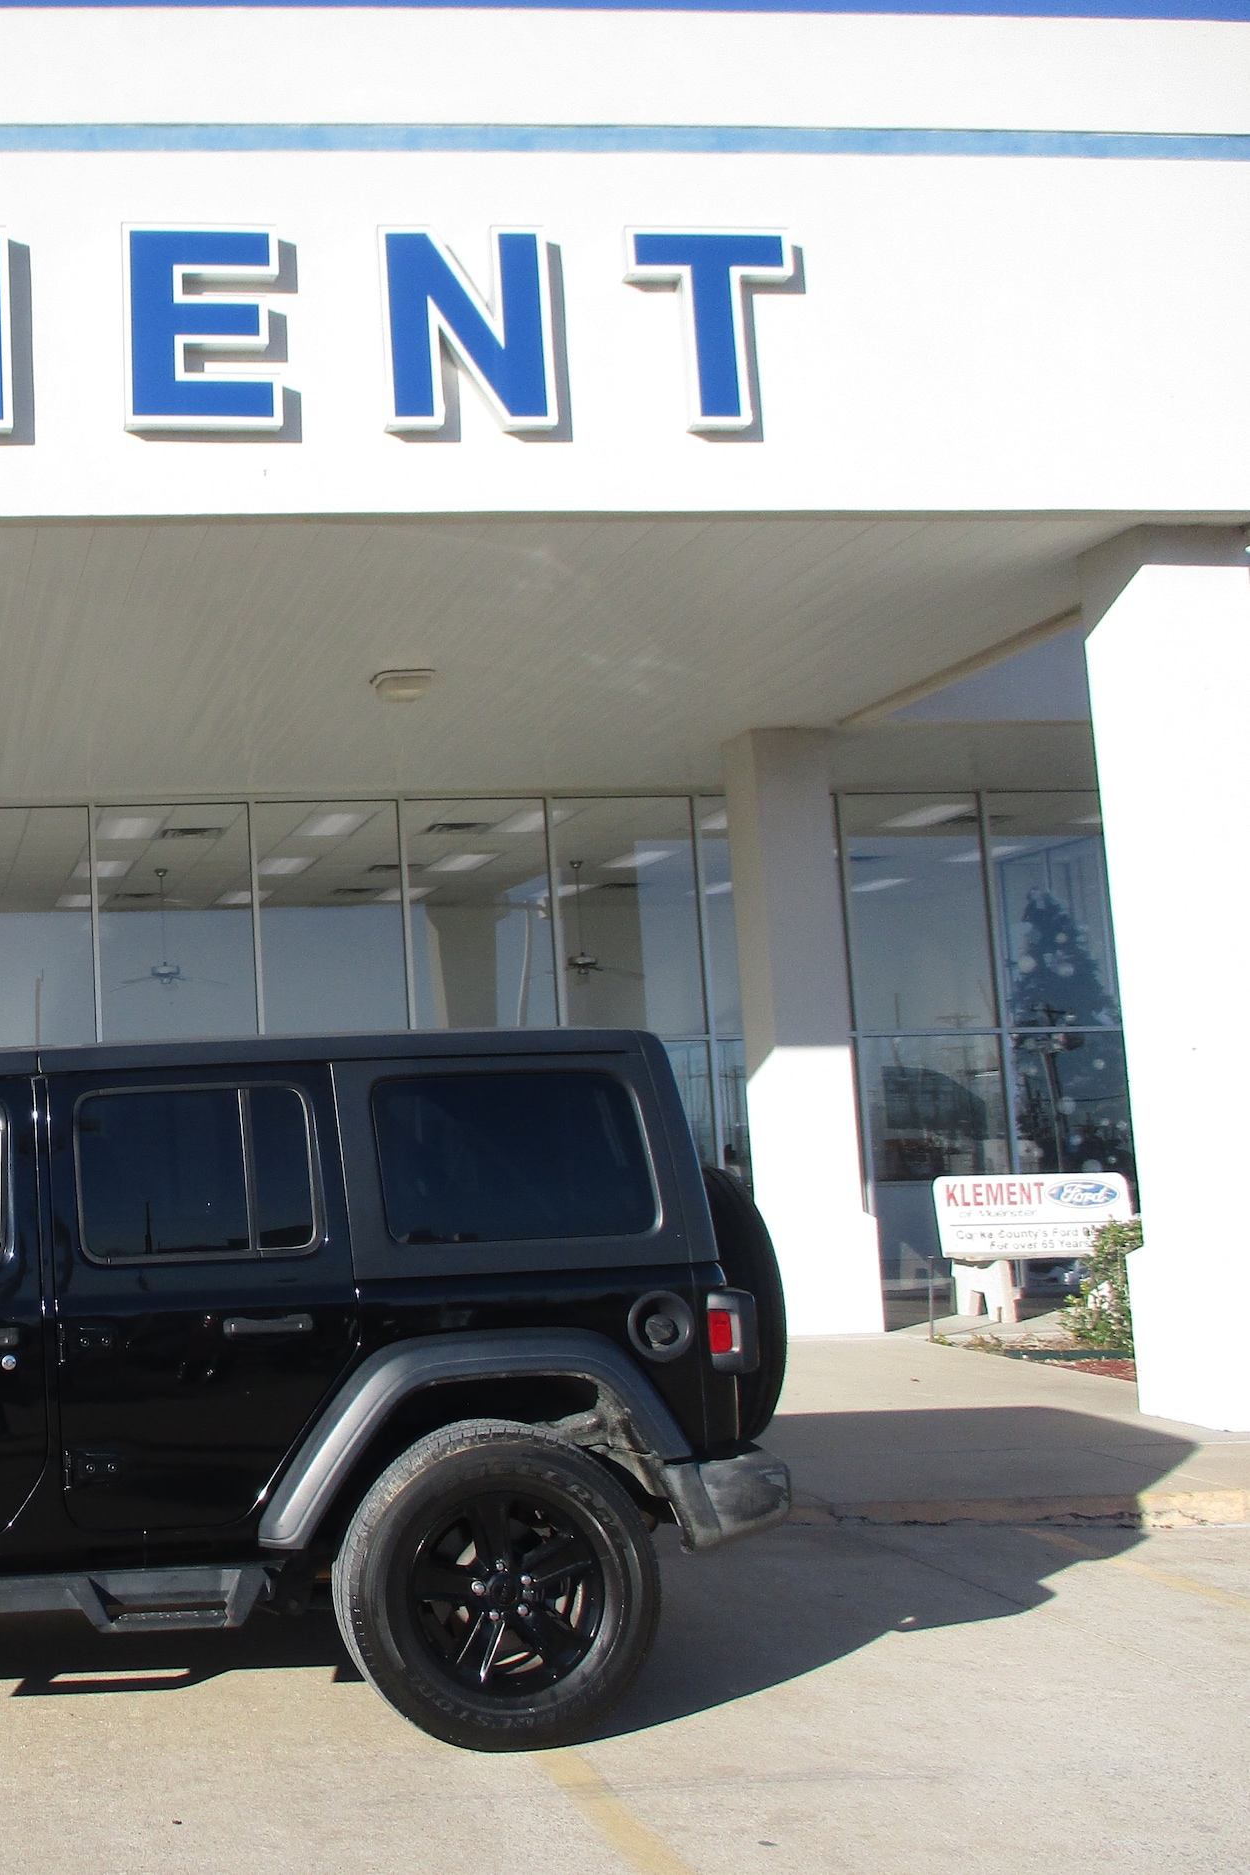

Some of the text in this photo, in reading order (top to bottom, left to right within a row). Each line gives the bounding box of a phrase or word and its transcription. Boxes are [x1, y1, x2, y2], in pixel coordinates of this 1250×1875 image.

[945, 1182, 1045, 1207] KLEMENT
[1060, 1182, 1105, 1204] Ford
[959, 1209, 973, 1218] of
[998, 1229, 1048, 1240] County's
[1052, 1228, 1078, 1237] Ford
[990, 1241, 1008, 1250] For
[1012, 1240, 1038, 1249] over
[1041, 1239, 1055, 1248] 65
